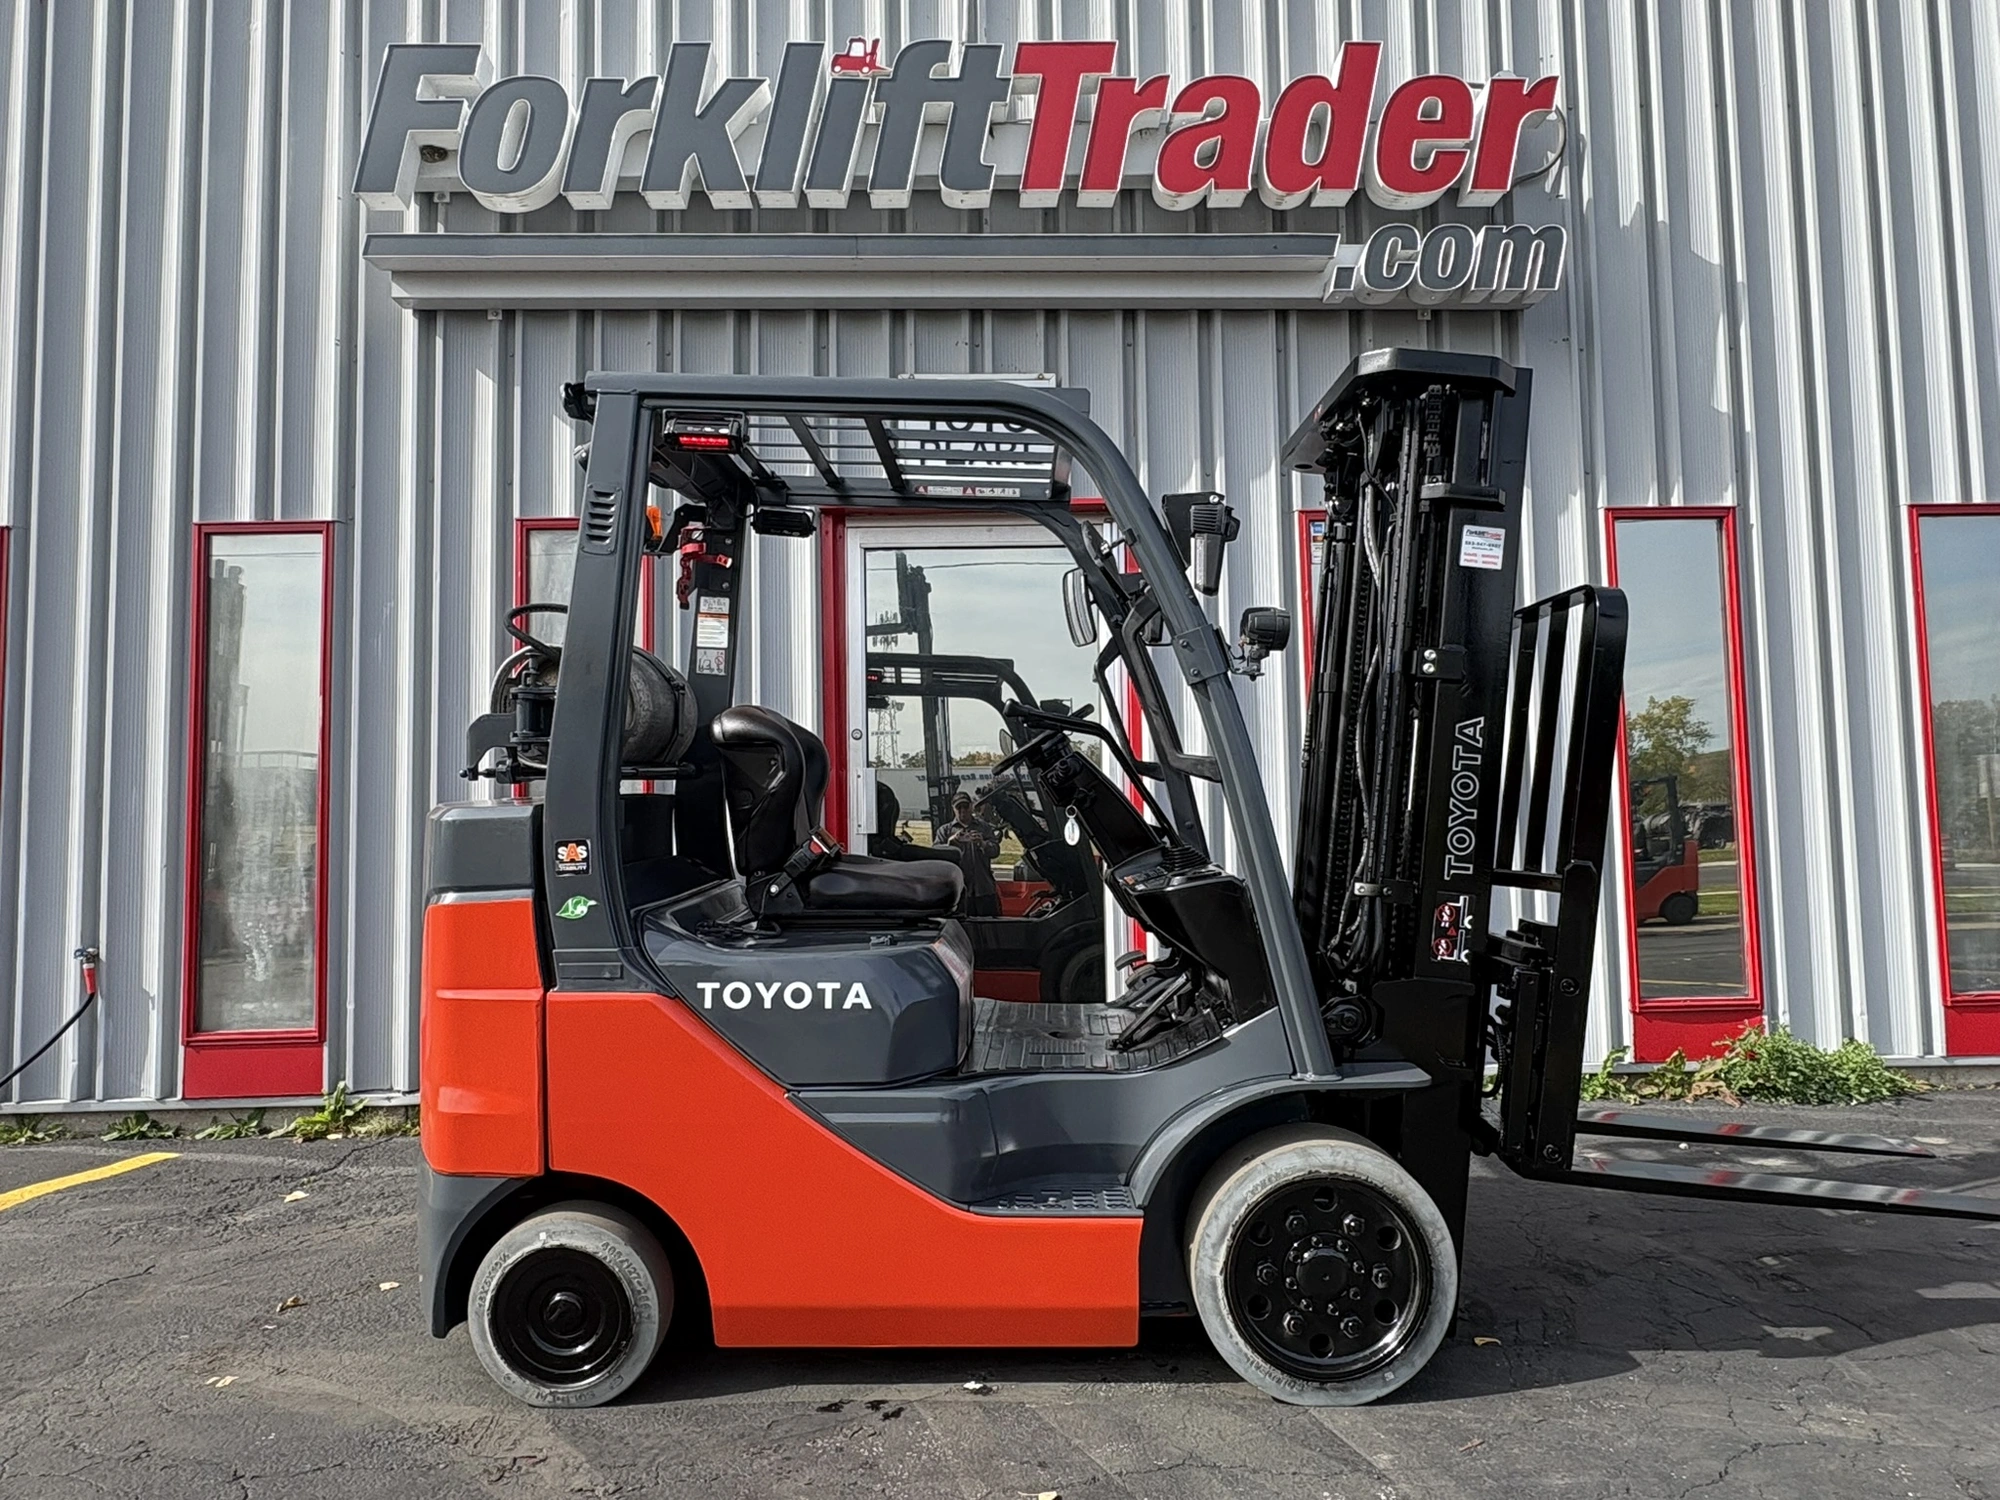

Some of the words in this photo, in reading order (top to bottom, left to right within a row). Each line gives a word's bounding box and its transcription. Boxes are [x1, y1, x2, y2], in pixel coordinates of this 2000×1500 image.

[1331, 222, 1568, 298] .com
[1444, 716, 1485, 880] TOYOTA
[557, 843, 588, 861] SAS
[696, 981, 873, 1010] TOYOTA
